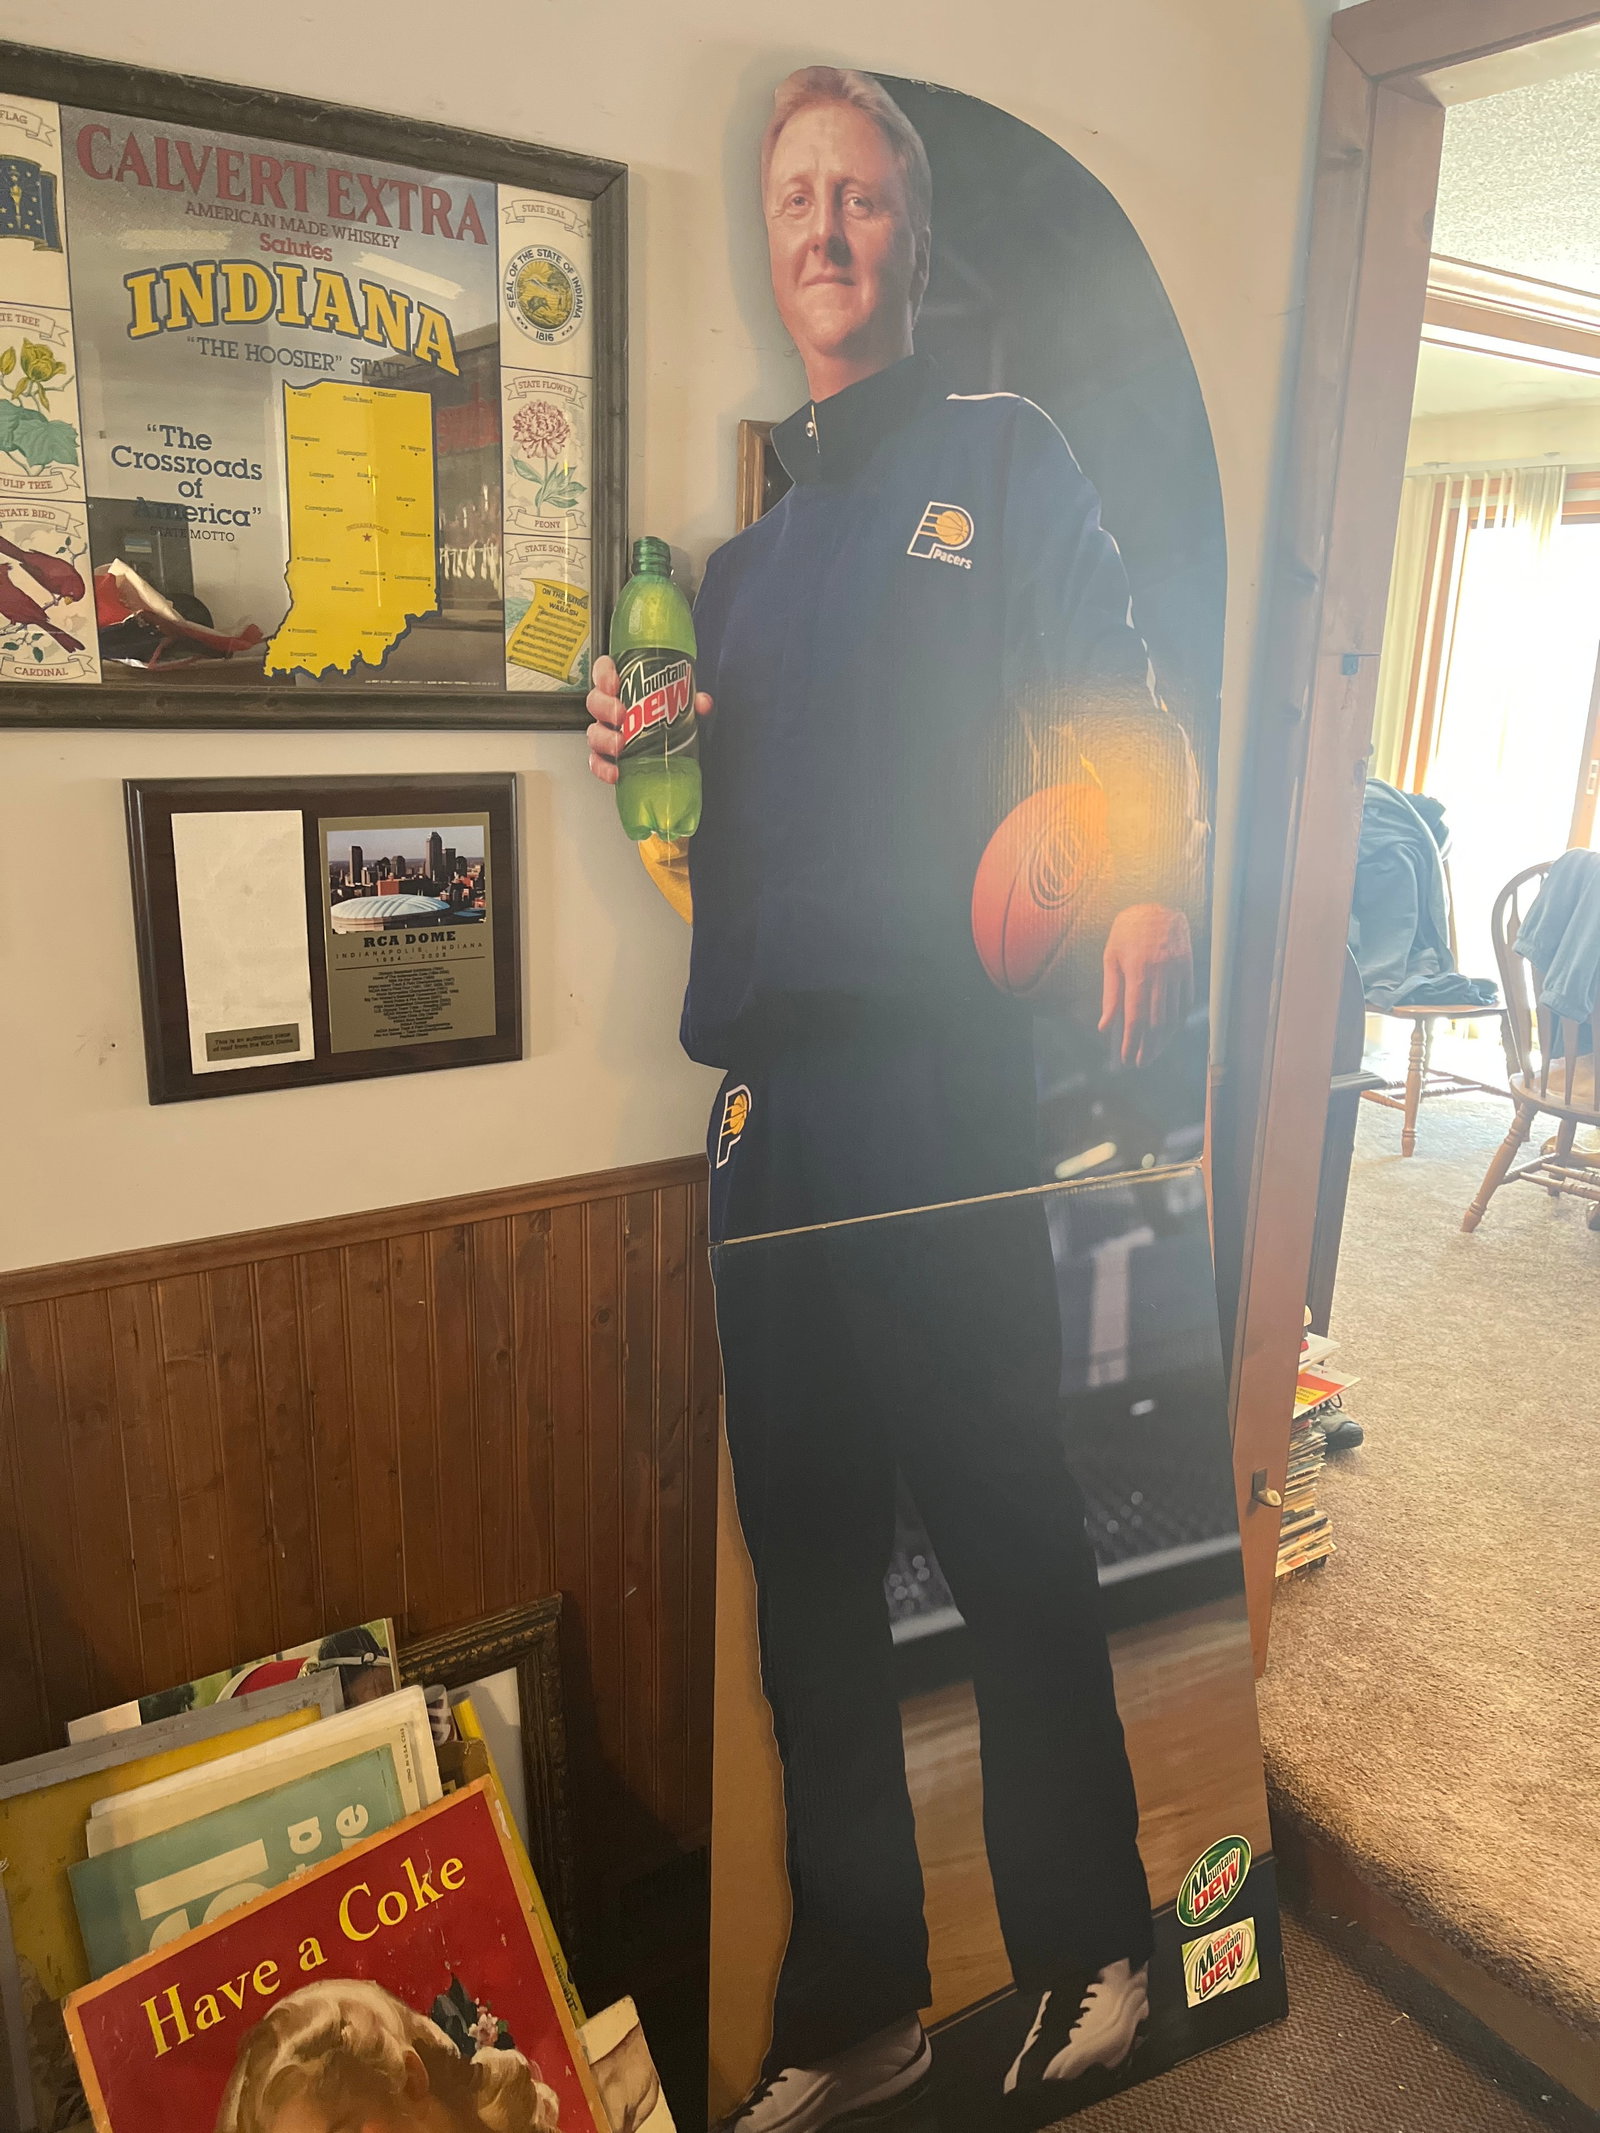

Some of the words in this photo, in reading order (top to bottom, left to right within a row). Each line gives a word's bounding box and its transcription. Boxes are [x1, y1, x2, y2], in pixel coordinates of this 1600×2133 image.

[76, 123, 316, 213] CALVERT
[326, 168, 489, 245] EXTRA
[522, 203, 546, 214] STATE
[546, 207, 567, 219] SEAL
[185, 201, 276, 230] AMERICAN
[279, 216, 328, 238] MADE
[331, 225, 400, 249] WHISKEY
[259, 233, 333, 262] Salutes
[517, 248, 534, 263] THE
[536, 248, 562, 264] STATE
[509, 262, 519, 278] OF
[563, 262, 575, 275] OF
[506, 280, 516, 309] SEAL
[571, 275, 584, 319] INDIANA
[16, 314, 40, 328] TREE
[123, 259, 460, 377] INDIANA
[535, 331, 555, 342] 1816
[350, 357, 406, 381] STATE
[518, 379, 542, 391] STATE
[542, 382, 574, 396] FLOWER
[111, 445, 263, 481] Crossroads
[27, 480, 53, 490] TREE
[178, 478, 204, 499] of
[0, 508, 29, 518] STATE
[32, 508, 56, 520] BIRD
[534, 519, 561, 529] PEONY
[150, 526, 187, 540] STATE
[190, 528, 235, 543] MOTTO
[525, 544, 548, 553] STATE
[933, 548, 973, 570] Pacers
[14, 666, 69, 677] CARDINAL
[619, 659, 689, 709] Mountain
[363, 935, 400, 948] RCA
[405, 931, 456, 945] DOME
[436, 942, 483, 951] INDIANA
[1189, 1849, 1237, 1912] Mountain
[1213, 1931, 1231, 1953] Diet
[140, 1958, 282, 2059] Have
[298, 1936, 328, 1973] a
[338, 1856, 467, 1943] Coke
[1196, 1931, 1241, 1990] Mountain
